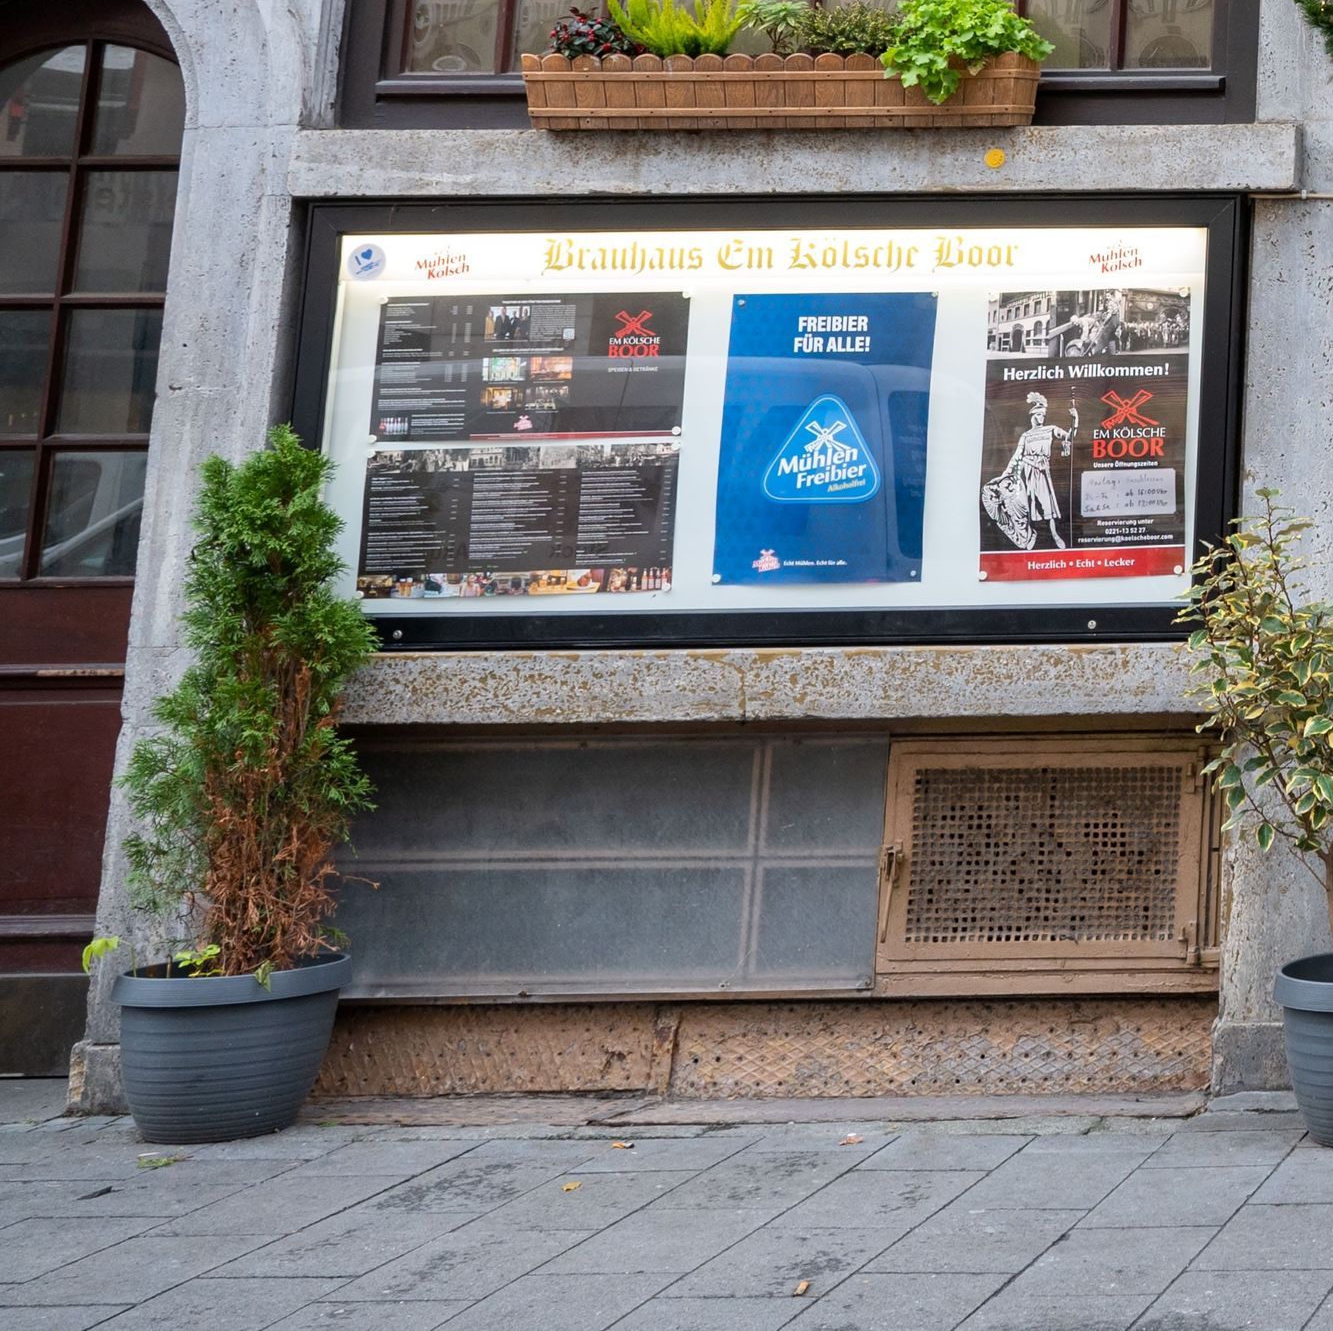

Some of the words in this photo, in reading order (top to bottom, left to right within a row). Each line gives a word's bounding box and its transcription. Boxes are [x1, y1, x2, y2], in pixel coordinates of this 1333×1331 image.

[541, 238, 703, 276] Brauhaus
[717, 239, 774, 270] Em
[787, 237, 919, 273] Kölsche
[931, 236, 1019, 273] Boor
[798, 315, 869, 332] FREIBIER
[609, 337, 621, 345] EM
[623, 335, 661, 345] KÖLSCHE
[793, 333, 824, 353] FÜR
[826, 336, 871, 353] ALLE!
[607, 344, 660, 358] BOOR
[1003, 365, 1064, 381] Herzlich
[1068, 362, 1170, 378] Willkommen!
[1093, 429, 1110, 439] EM
[1113, 426, 1166, 439] KÖLSCHE
[1093, 438, 1165, 458] BOOR
[777, 447, 858, 476] Mühlen
[1114, 460, 1158, 468] Öffnungszeiten
[796, 463, 867, 489] Freibier
[827, 478, 866, 492] Alkoholfrei
[1027, 559, 1067, 570] Herzlich
[1075, 558, 1095, 568] Echt
[1104, 557, 1136, 567] Lecker
